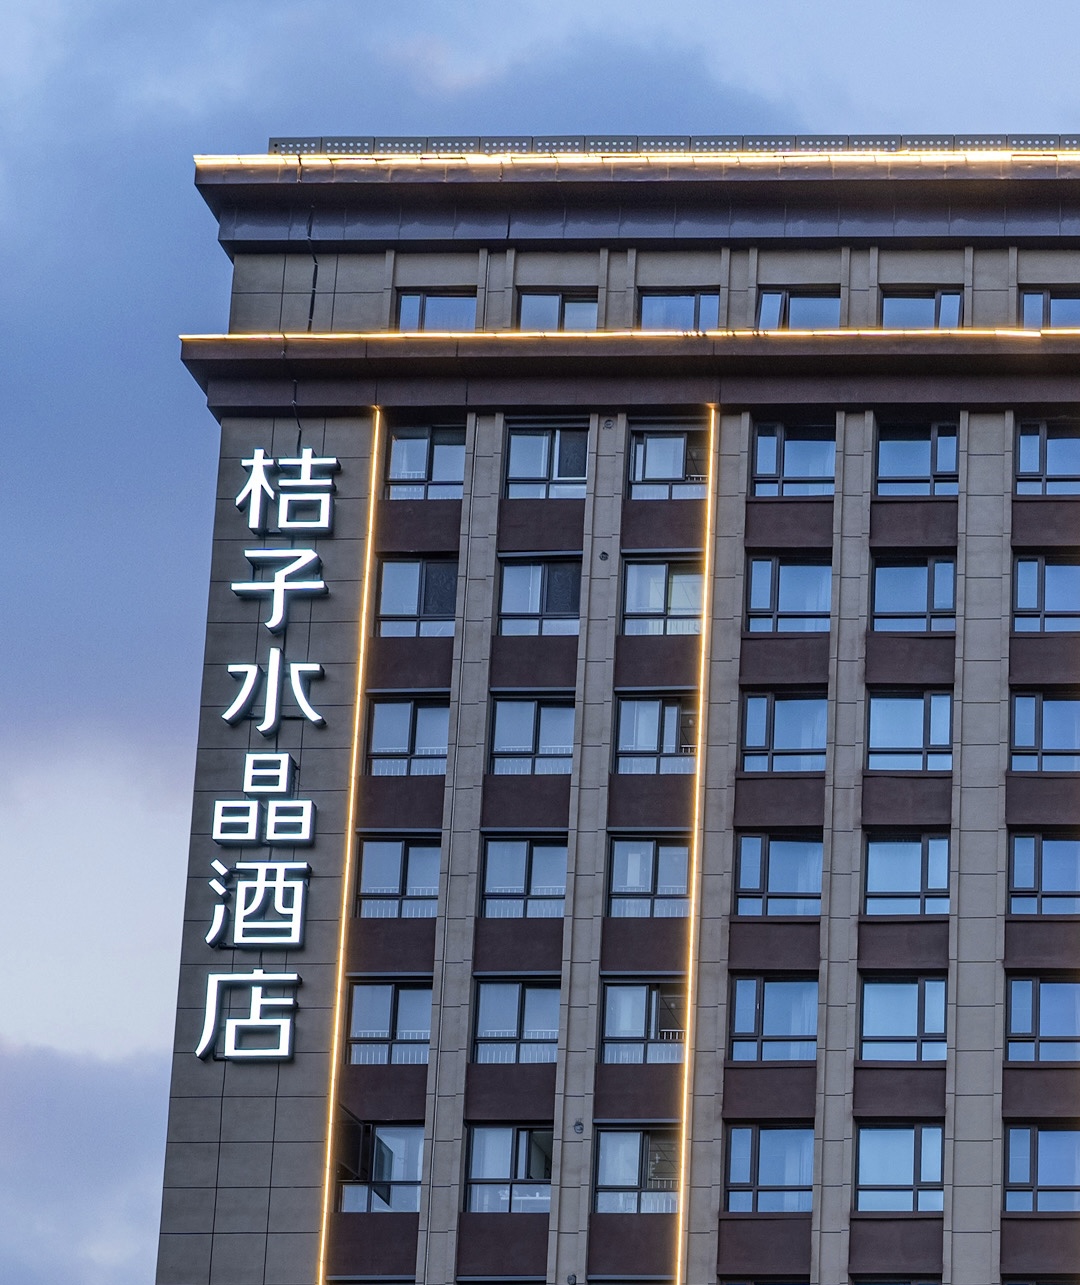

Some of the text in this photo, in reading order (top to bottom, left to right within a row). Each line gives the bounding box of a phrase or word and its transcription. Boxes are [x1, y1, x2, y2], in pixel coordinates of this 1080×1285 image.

[195, 446, 338, 1063] 桔子水晶酒店
